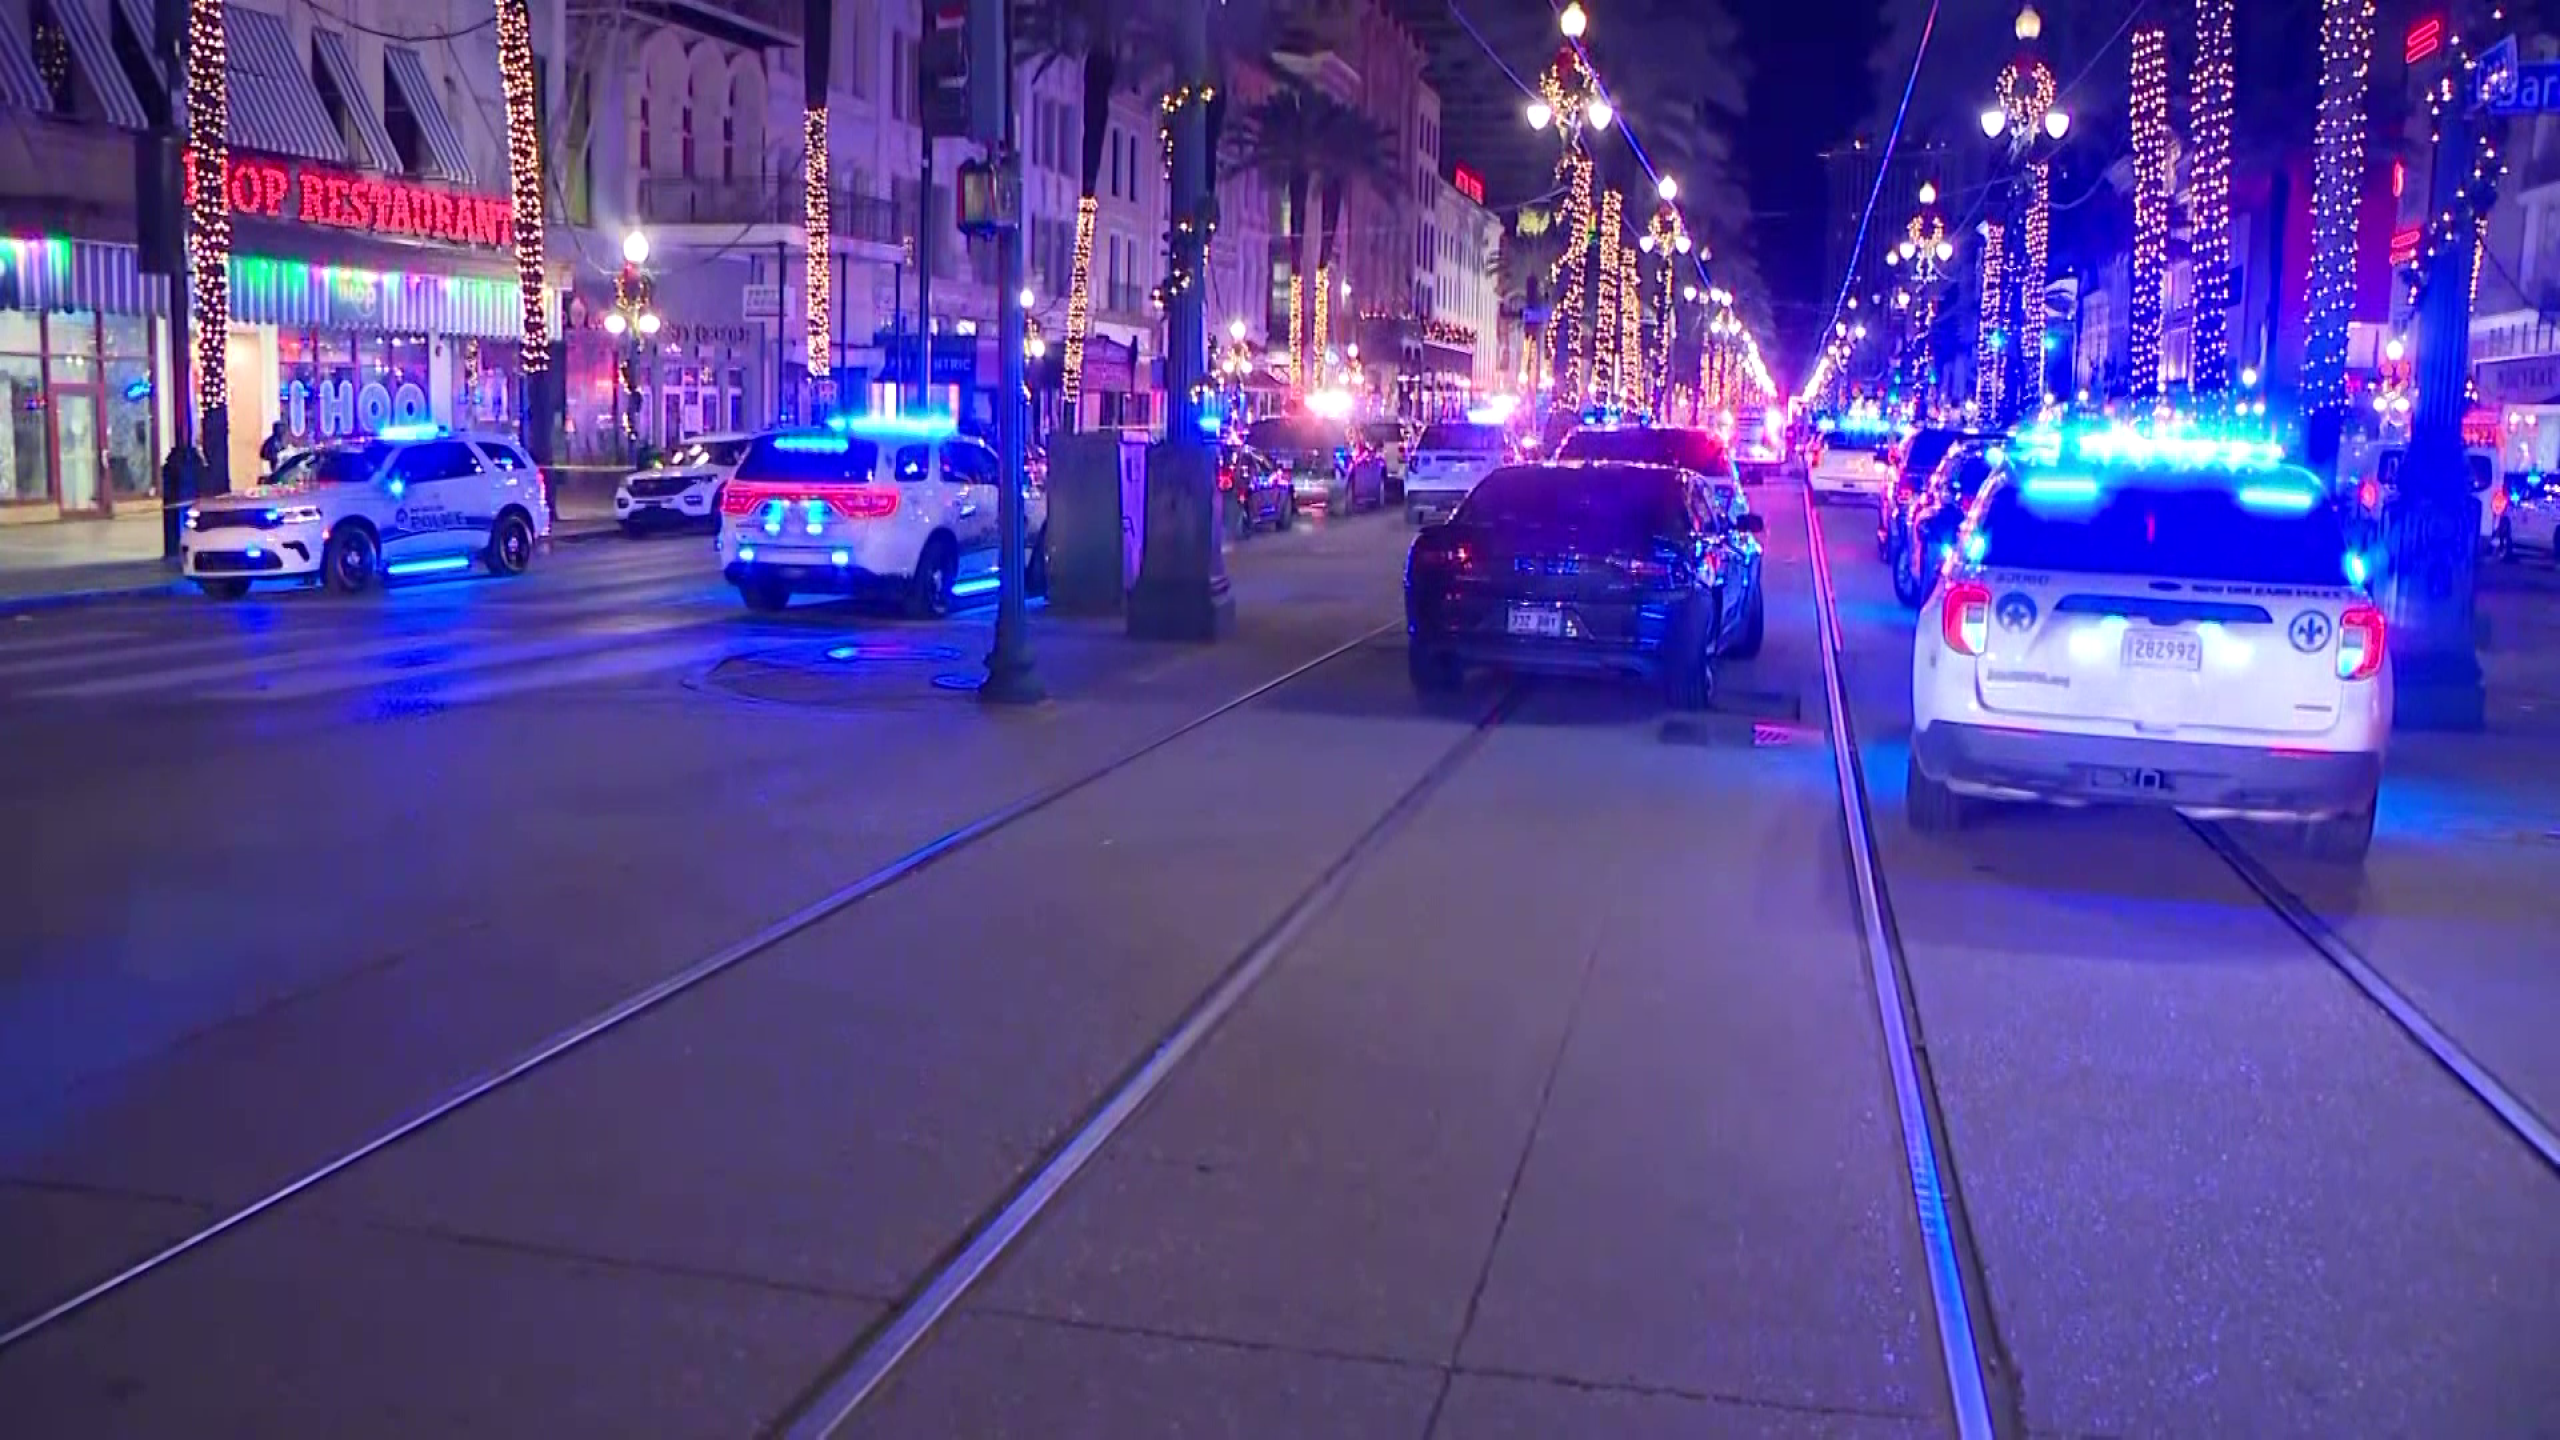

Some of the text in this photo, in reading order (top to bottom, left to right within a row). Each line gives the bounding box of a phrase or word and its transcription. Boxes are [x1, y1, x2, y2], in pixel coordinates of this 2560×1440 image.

[184, 147, 514, 246] IOP RESTAURANT
[2135, 639, 2197, 661] 282992
